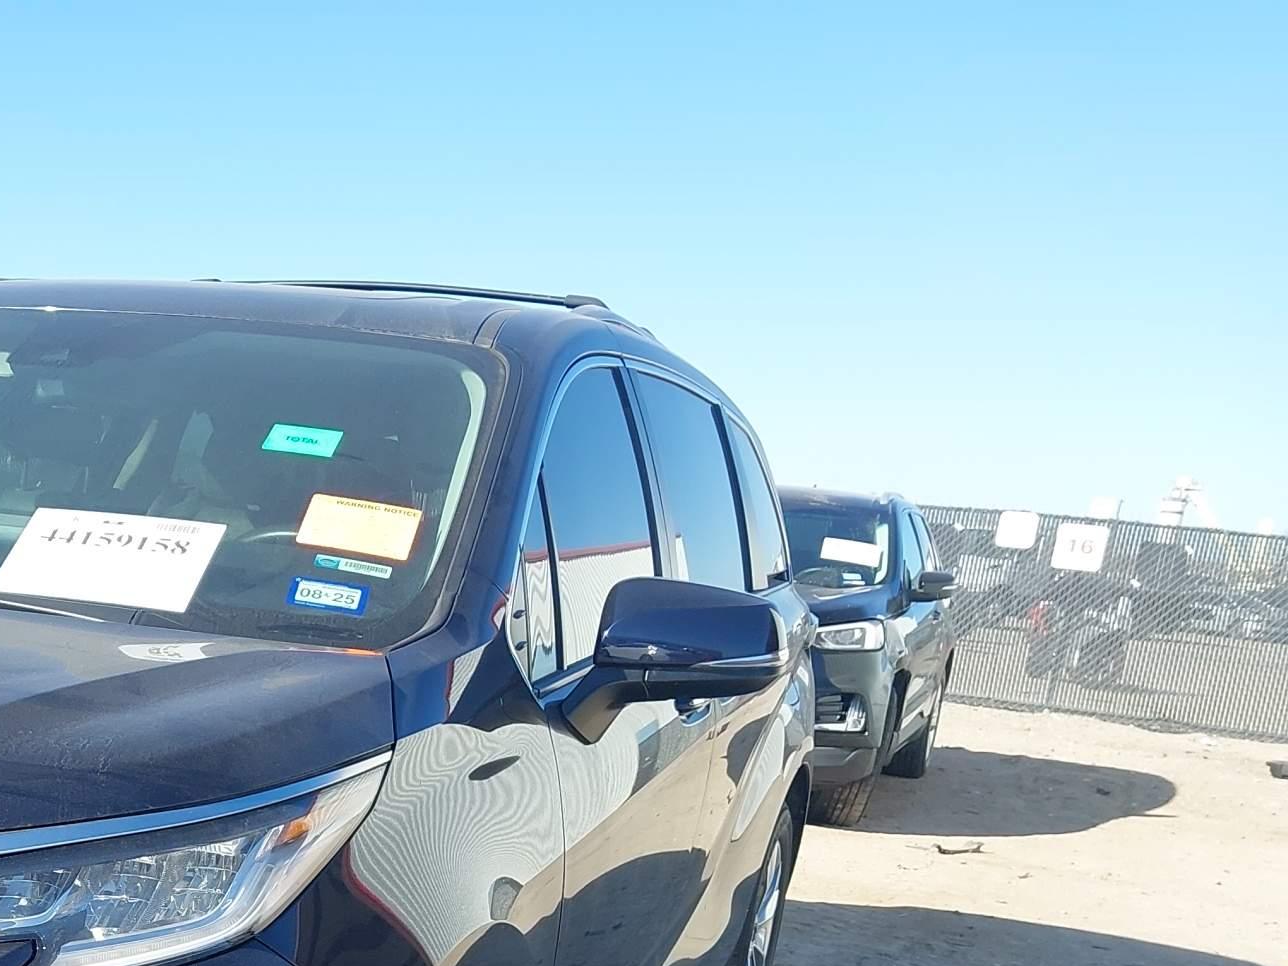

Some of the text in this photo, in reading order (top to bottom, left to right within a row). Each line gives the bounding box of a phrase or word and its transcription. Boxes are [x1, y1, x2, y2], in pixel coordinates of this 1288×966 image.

[336, 500, 419, 518] WARNING NOTICE
[40, 527, 191, 555] 44159158
[1069, 539, 1094, 554] 16
[299, 587, 323, 600] 08
[331, 592, 356, 605] 25
